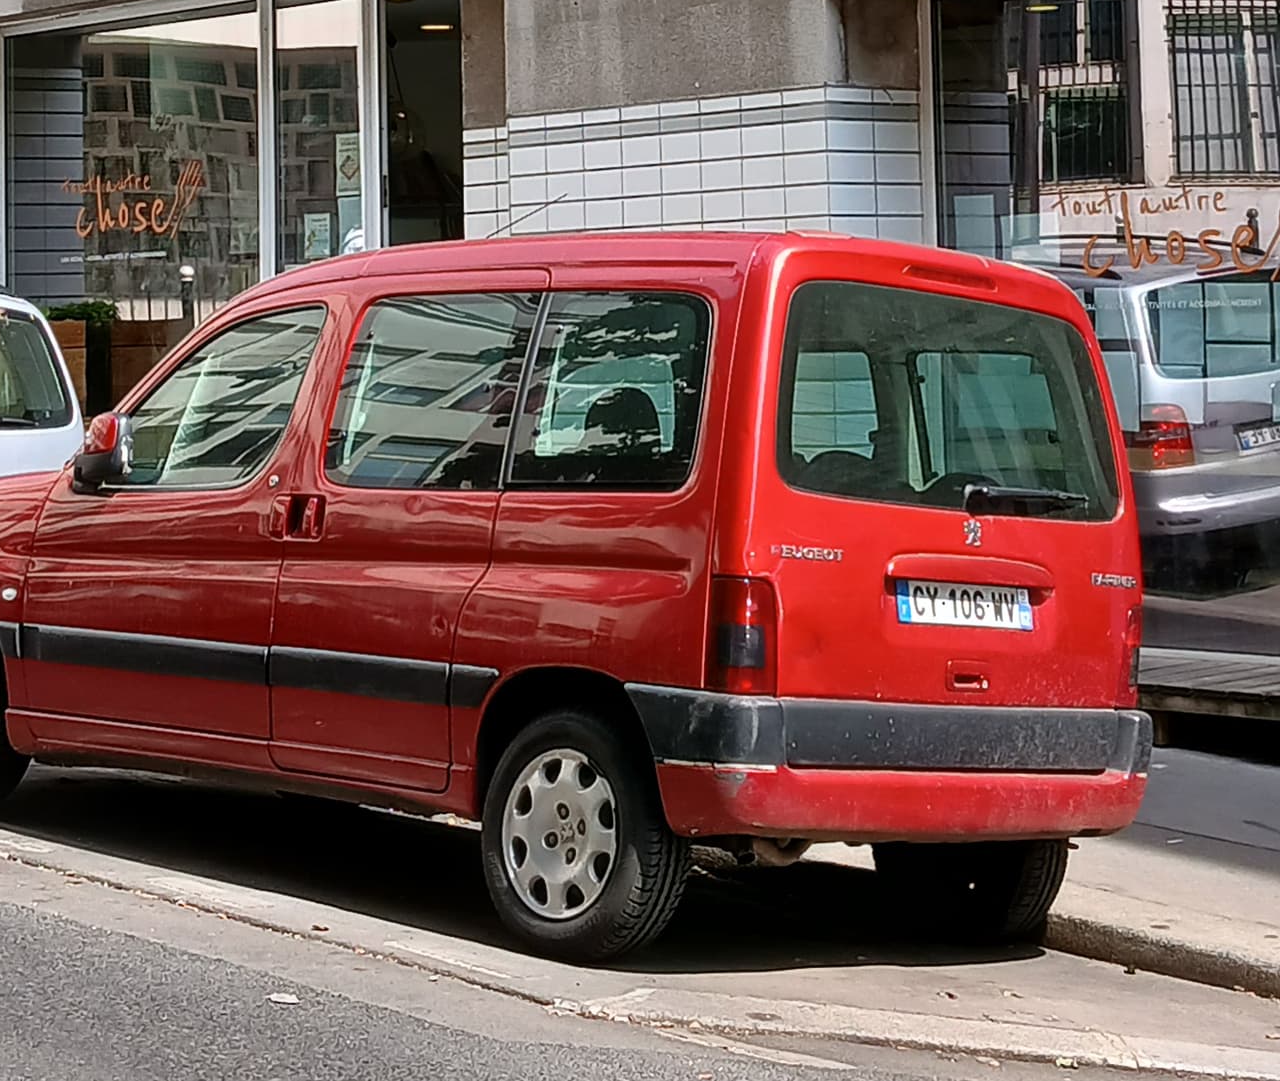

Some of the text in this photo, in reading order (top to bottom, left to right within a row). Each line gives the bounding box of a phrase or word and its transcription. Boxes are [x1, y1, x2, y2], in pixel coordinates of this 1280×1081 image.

[76, 175, 172, 238] chose
[1051, 183, 1227, 217] tout autre
[1083, 191, 1272, 277] chose
[770, 544, 844, 562] PEUGEOT
